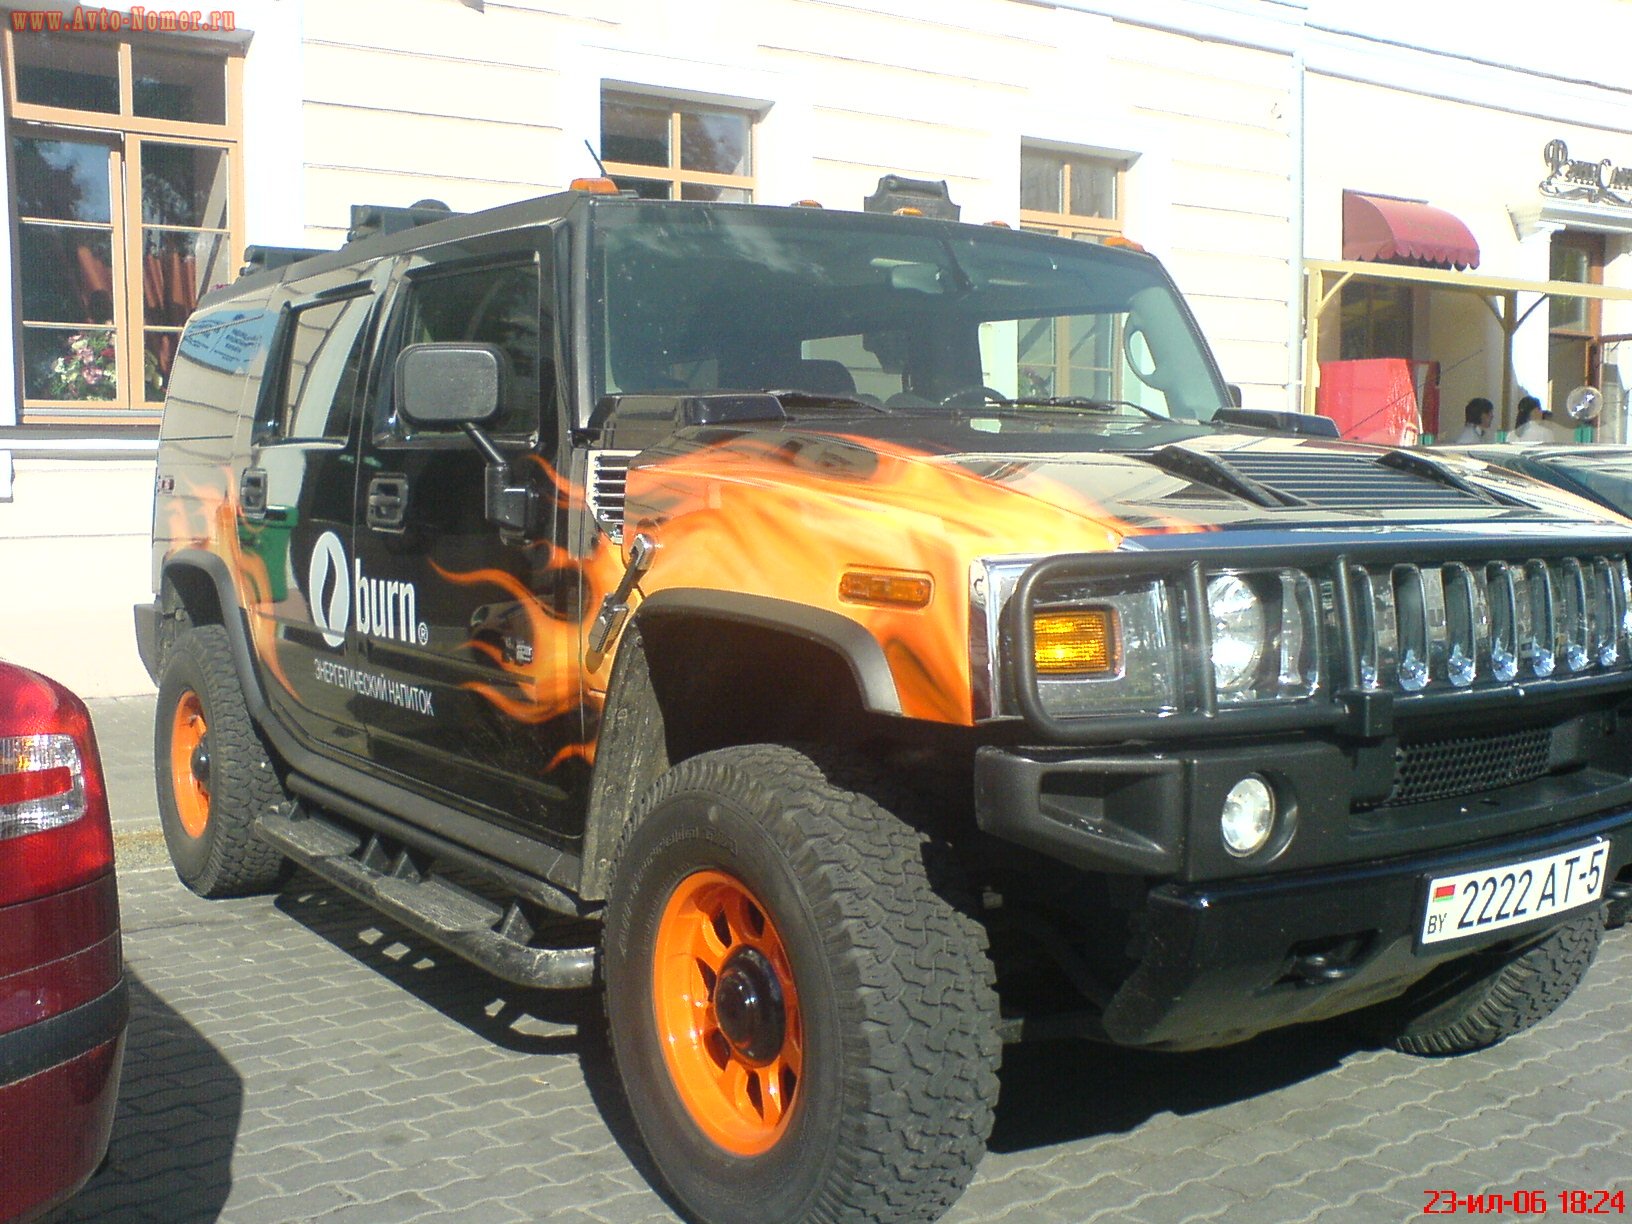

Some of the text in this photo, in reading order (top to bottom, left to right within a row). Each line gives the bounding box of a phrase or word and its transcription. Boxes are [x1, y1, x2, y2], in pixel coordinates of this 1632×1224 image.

[314, 658, 435, 717] ЭНЕРГЕТИЧЕСКИЙ НАПИТОК
[1457, 849, 1604, 930] 2222 AT-5
[1427, 913, 1448, 935] BY
